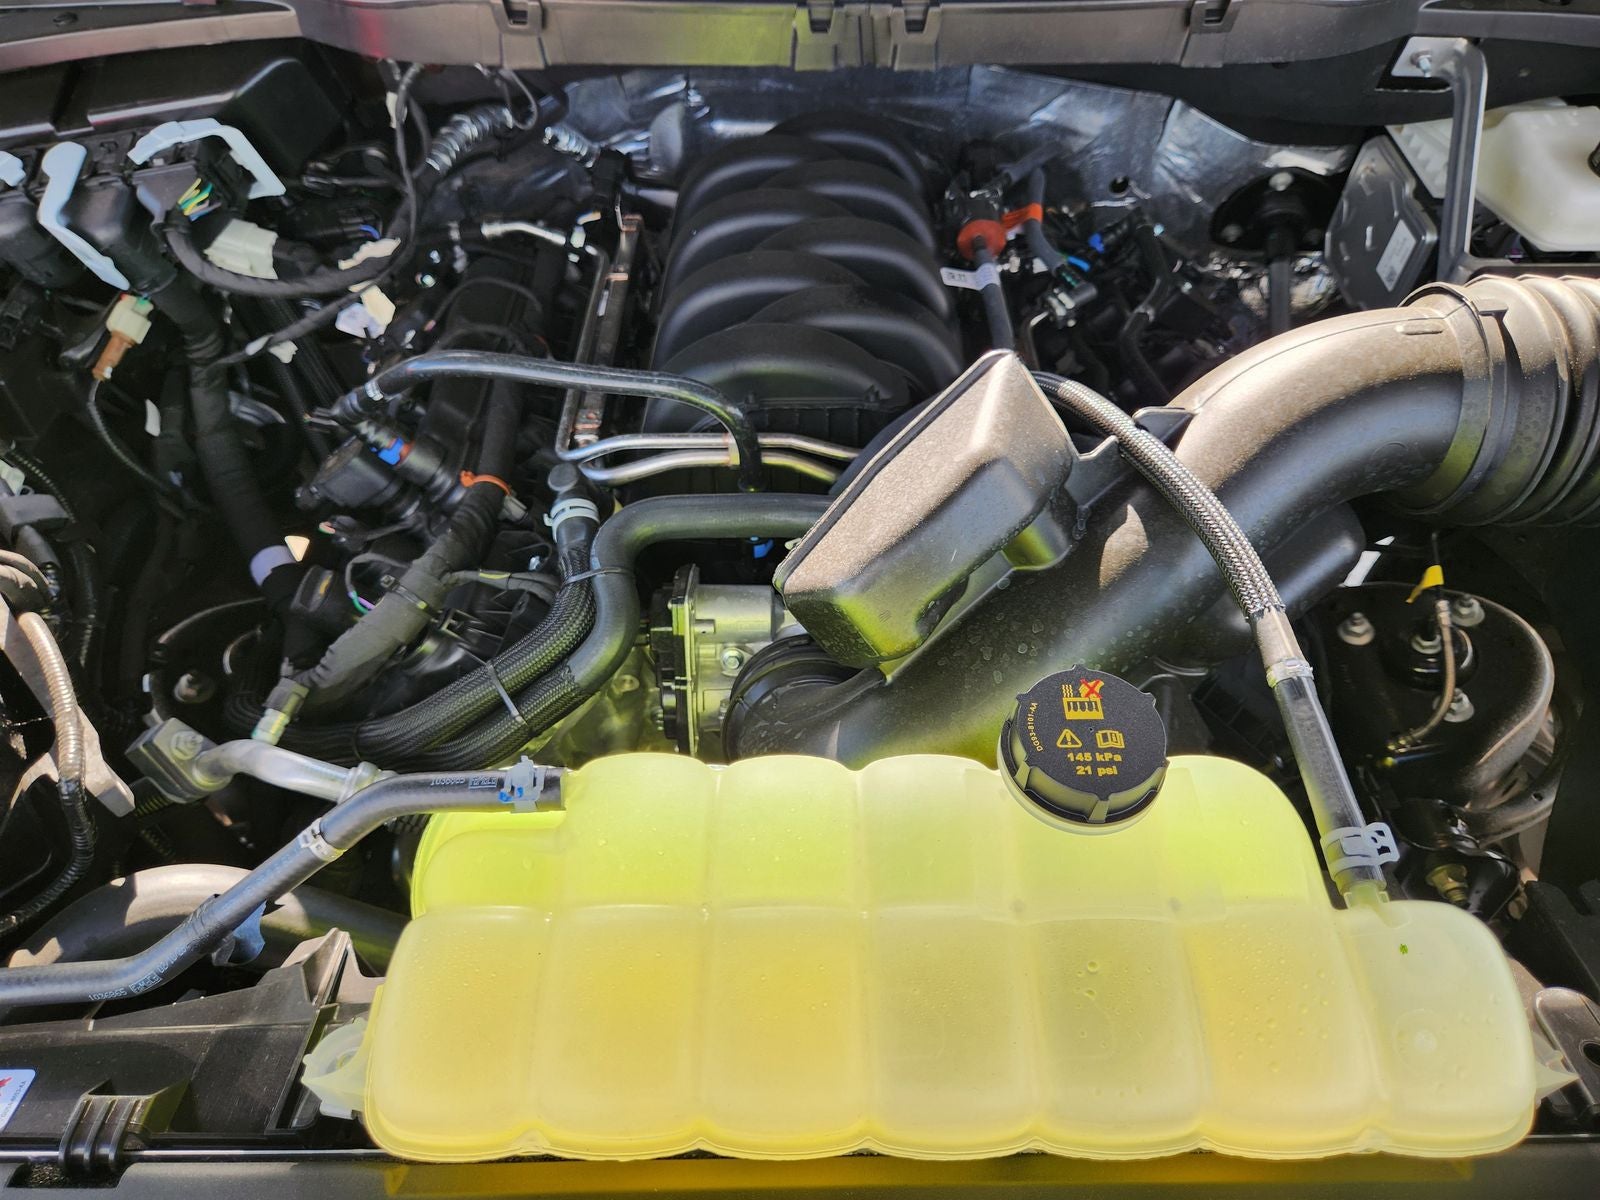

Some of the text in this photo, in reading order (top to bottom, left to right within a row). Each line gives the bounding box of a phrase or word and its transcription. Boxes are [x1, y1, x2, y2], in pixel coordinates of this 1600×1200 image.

[1067, 752, 1122, 762] 145 kPa
[1076, 765, 1118, 776] 21 psi
